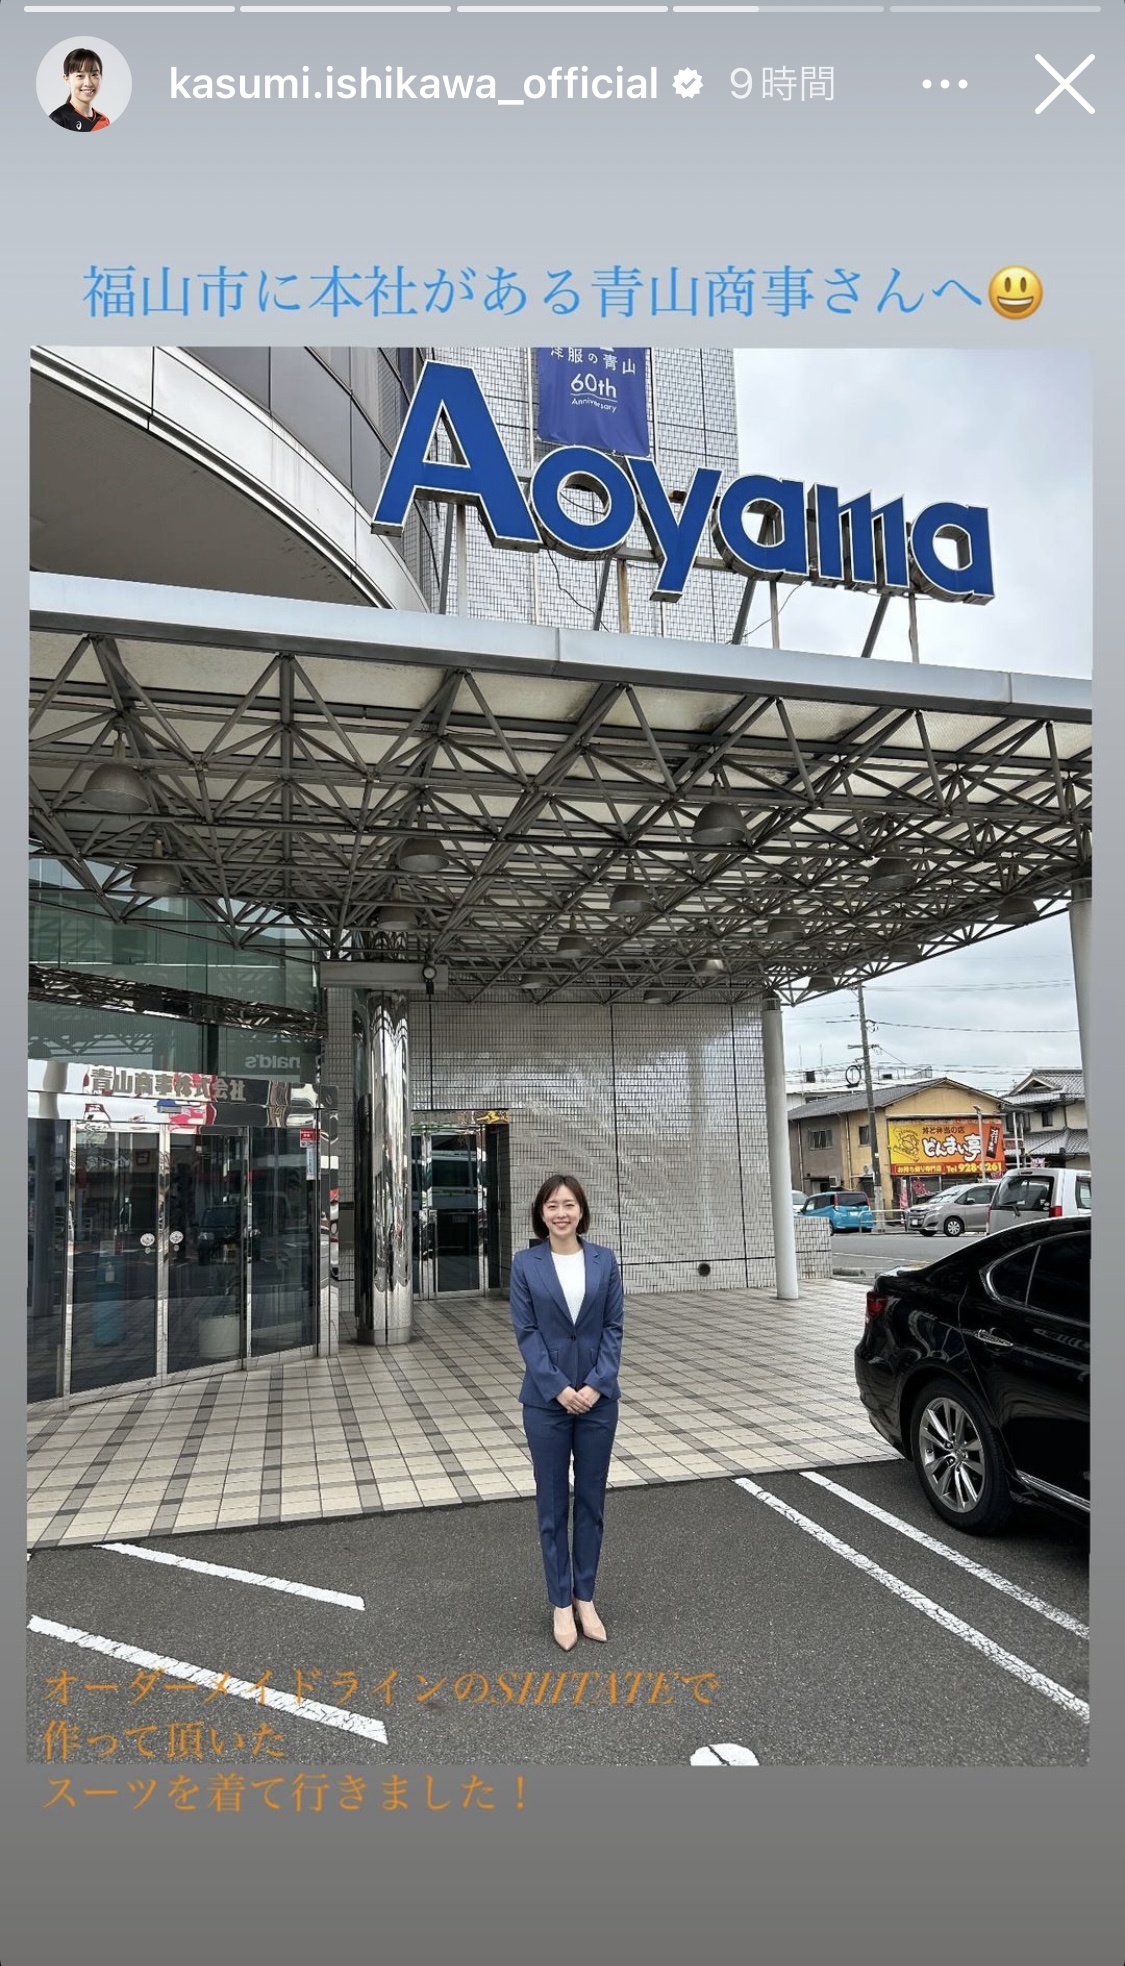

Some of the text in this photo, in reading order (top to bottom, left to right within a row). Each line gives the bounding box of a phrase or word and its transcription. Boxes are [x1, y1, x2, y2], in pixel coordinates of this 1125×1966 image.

[551, 347, 636, 375] 洋服の青山
[570, 373, 617, 399] 60th
[571, 398, 617, 413] Anniversary
[371, 360, 994, 604] Aoyama
[91, 1067, 246, 1101] 青山商事株式会社
[946, 1165, 957, 1173] Tel
